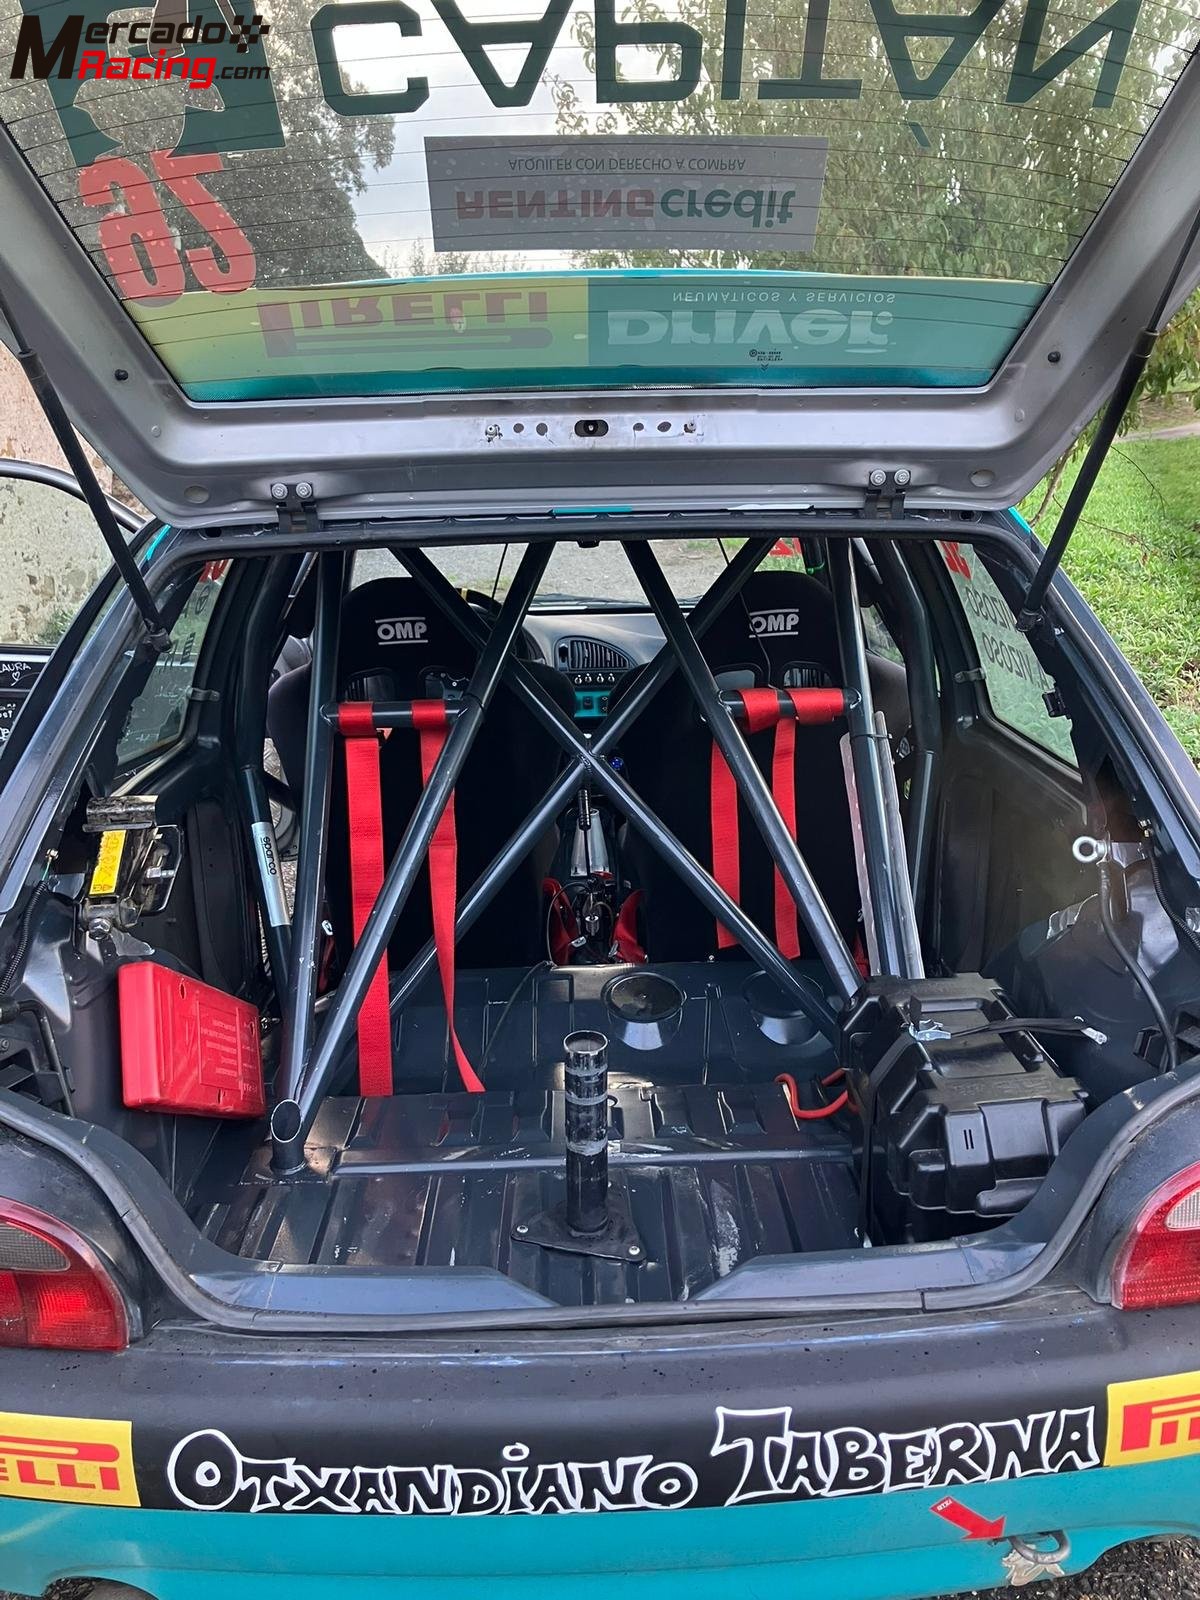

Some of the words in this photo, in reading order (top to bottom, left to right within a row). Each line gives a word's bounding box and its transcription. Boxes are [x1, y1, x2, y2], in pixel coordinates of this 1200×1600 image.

[377, 621, 428, 640] OMP
[749, 613, 800, 633] OMP
[263, 836, 277, 875] sparco
[710, 1405, 1100, 1507] TABERNA
